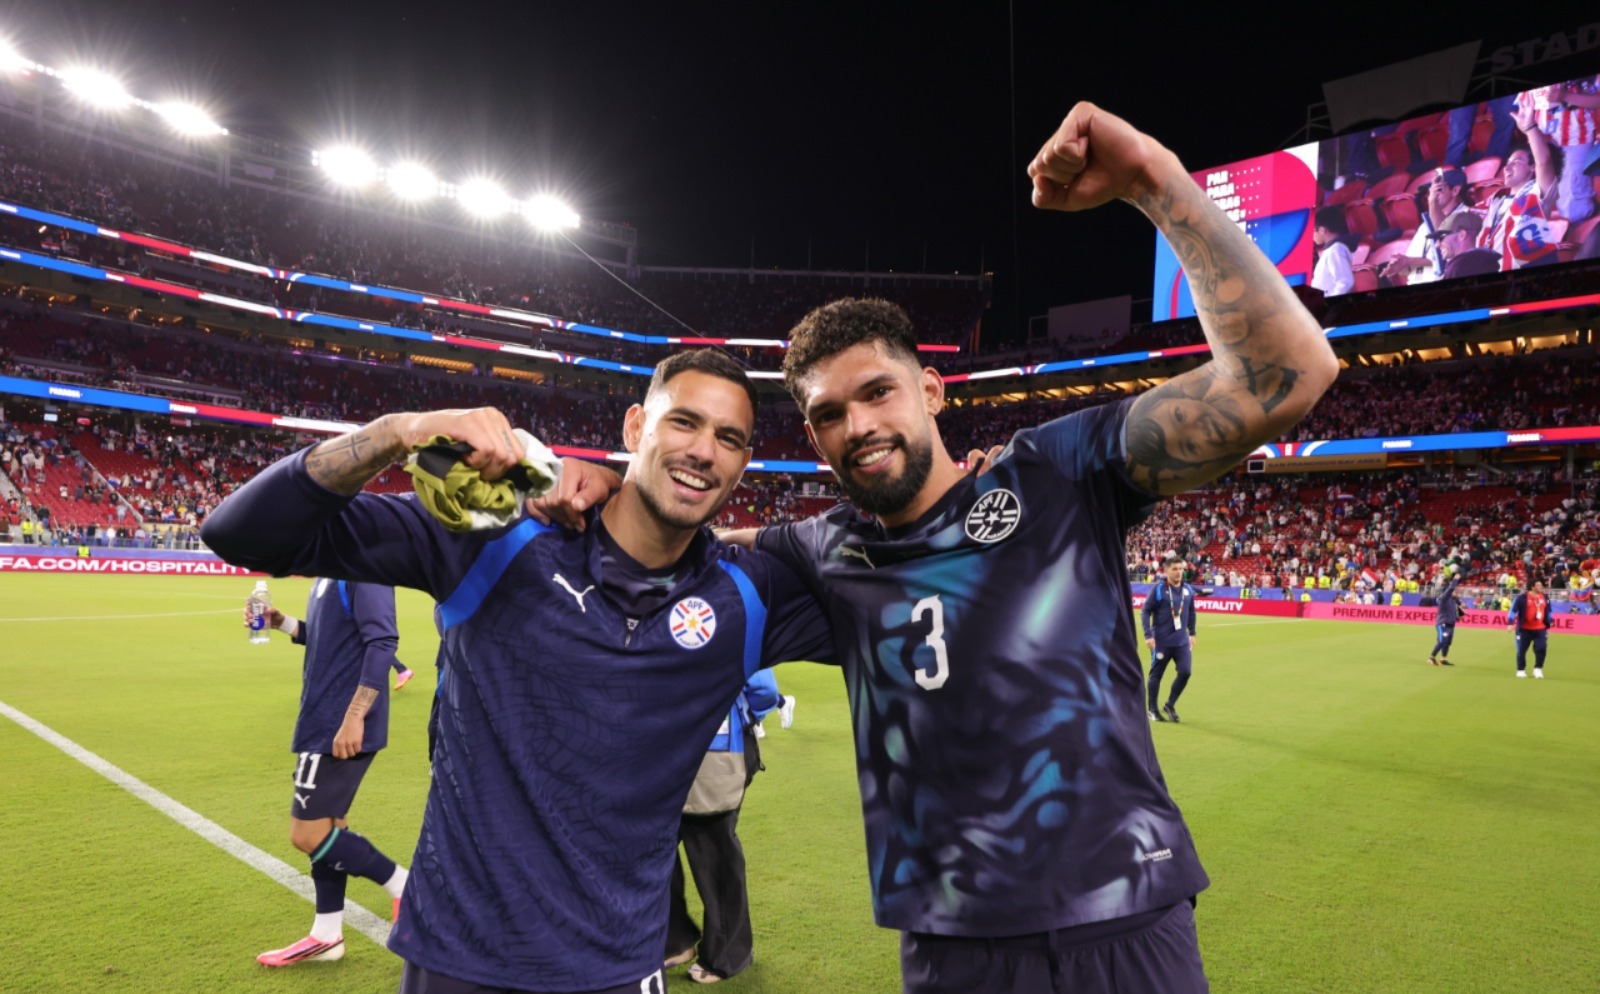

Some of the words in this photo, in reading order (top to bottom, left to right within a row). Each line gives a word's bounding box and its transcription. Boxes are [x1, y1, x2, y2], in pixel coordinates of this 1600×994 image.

[687, 600, 704, 610] APF
[1333, 607, 1393, 620] PREMIUM
[911, 594, 949, 691] 3
[295, 752, 322, 789] 11
